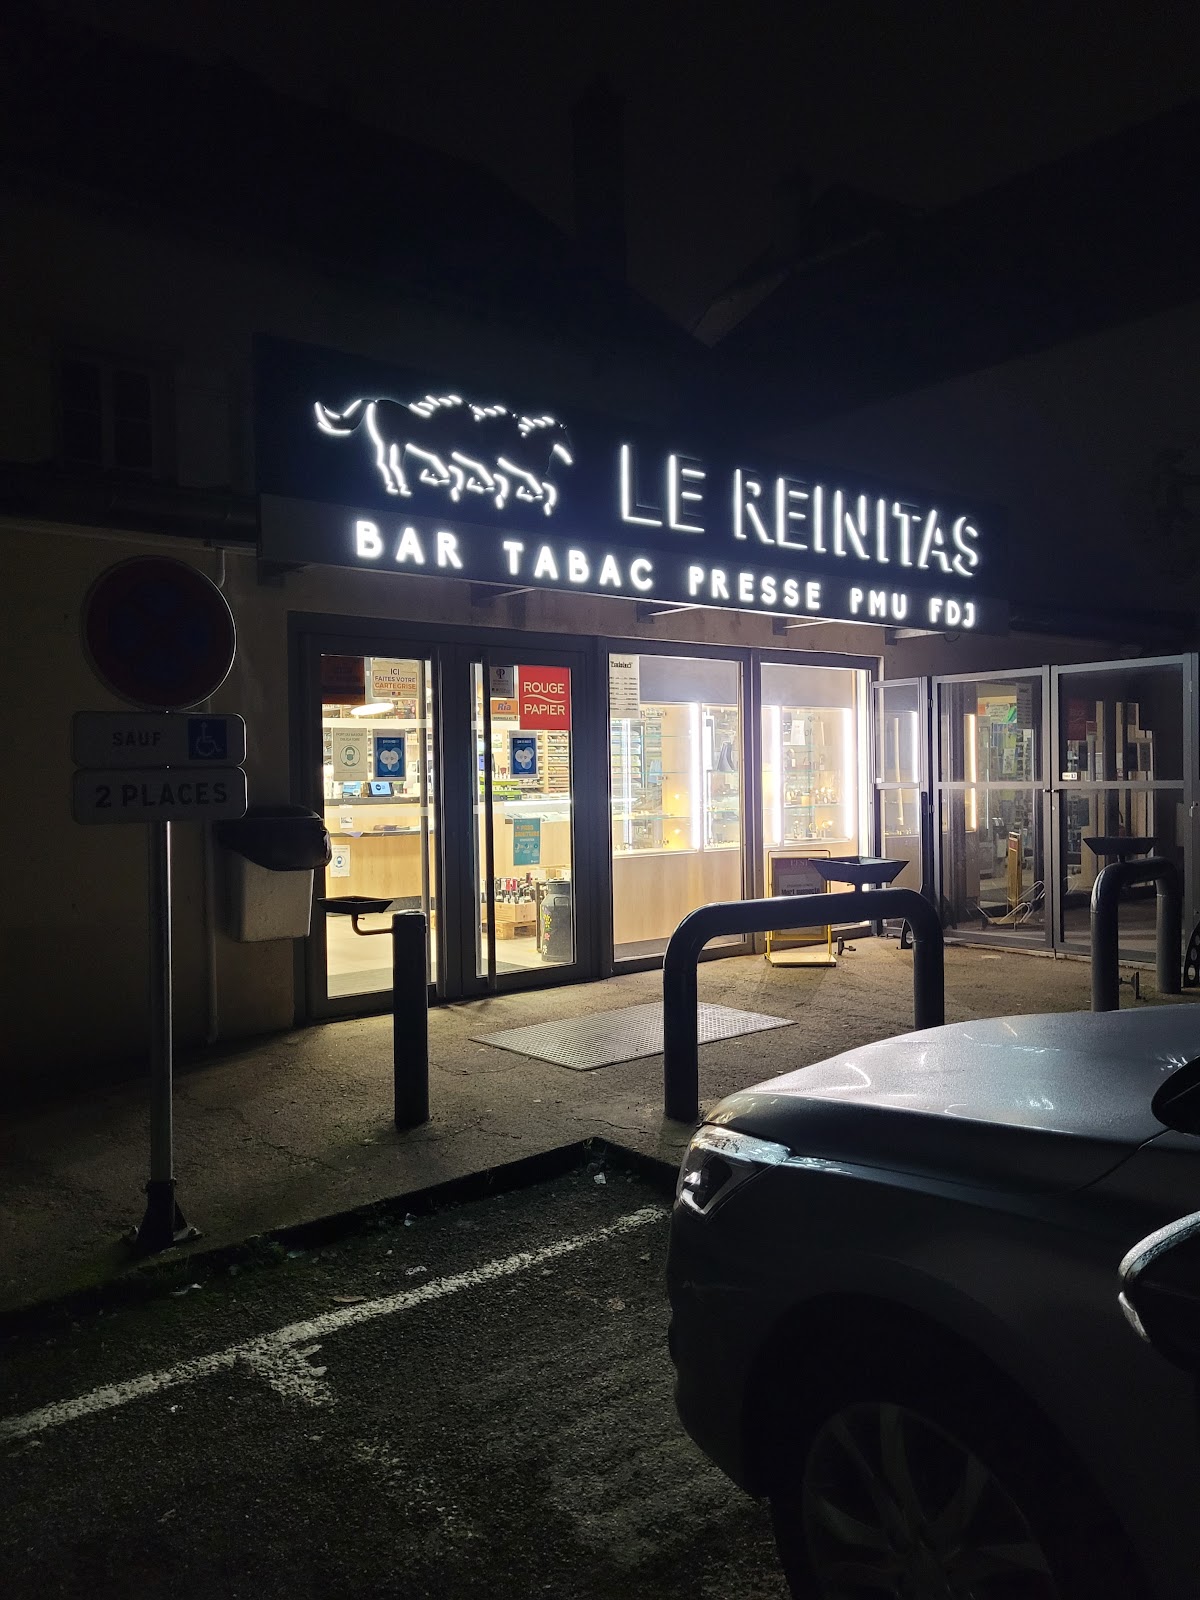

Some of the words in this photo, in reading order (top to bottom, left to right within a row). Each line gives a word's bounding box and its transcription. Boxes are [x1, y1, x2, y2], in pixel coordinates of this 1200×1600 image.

[619, 443, 707, 534] LE
[733, 467, 979, 578] REINITAS
[354, 518, 464, 570] BAR
[502, 539, 654, 593] TABAC
[687, 564, 822, 612] PRESSE
[849, 586, 909, 621] PMU
[929, 596, 977, 629] FDJ
[523, 681, 565, 694] ROUGE
[497, 701, 512, 711] Ria
[524, 703, 566, 716] PAPIER
[112, 731, 162, 747] SAUF
[95, 784, 112, 809] 2
[122, 782, 228, 807] PLACES
